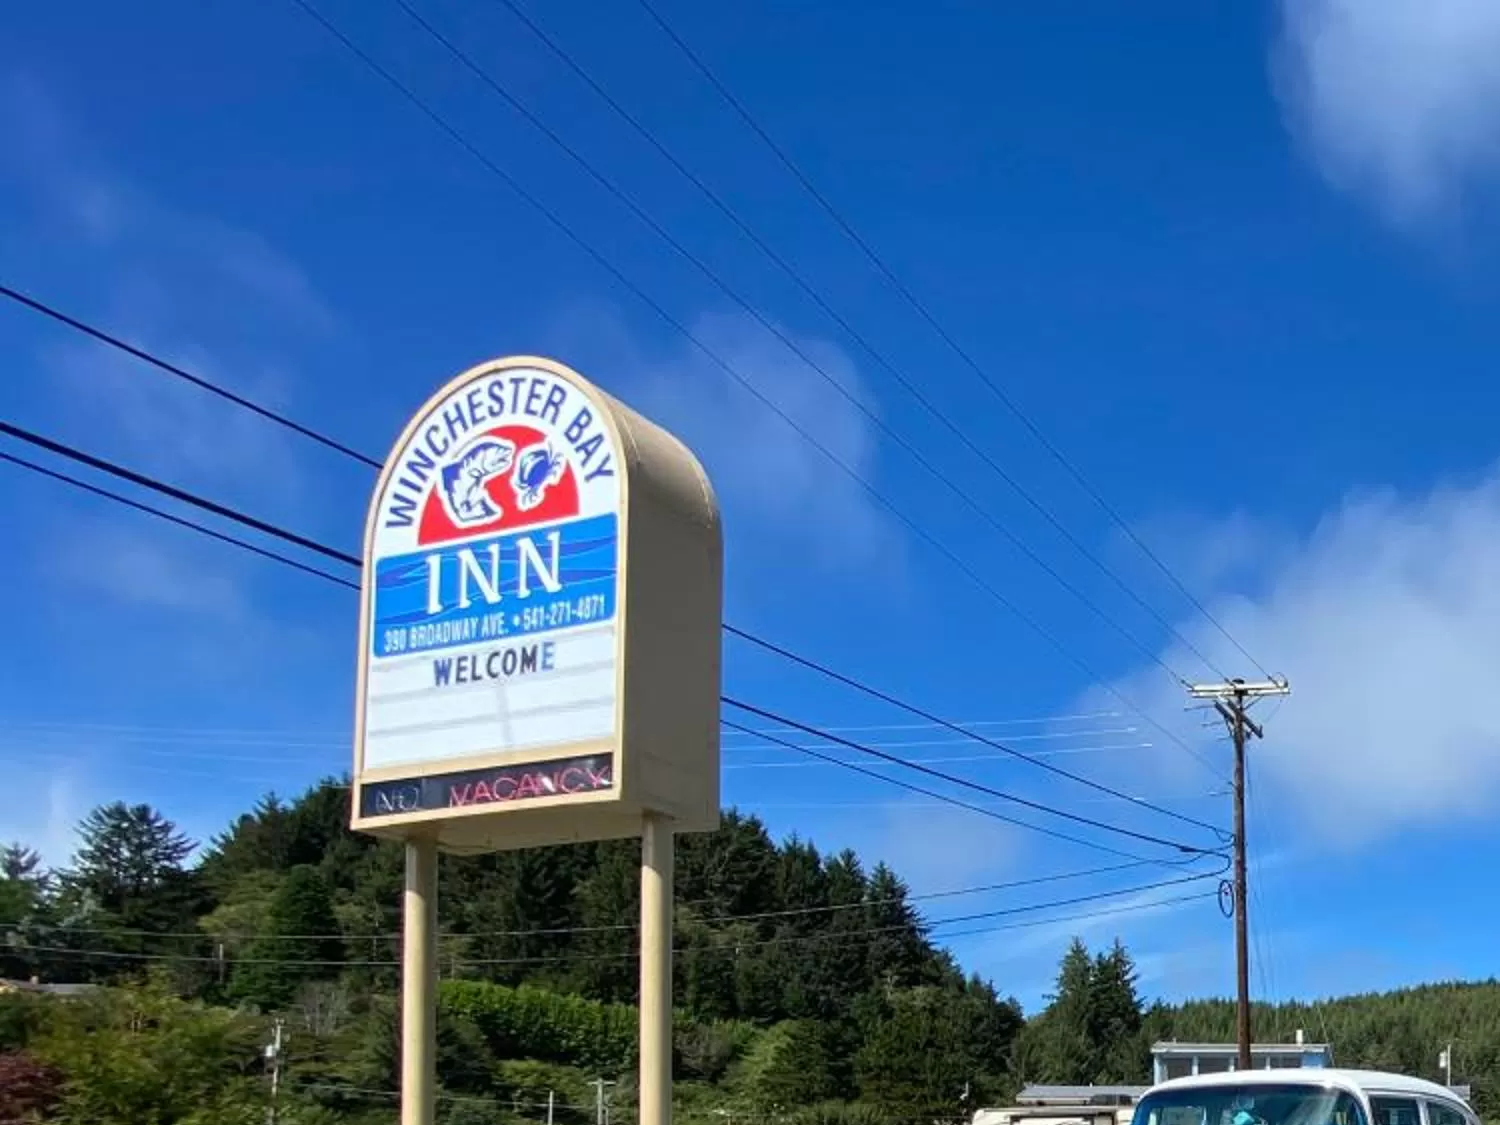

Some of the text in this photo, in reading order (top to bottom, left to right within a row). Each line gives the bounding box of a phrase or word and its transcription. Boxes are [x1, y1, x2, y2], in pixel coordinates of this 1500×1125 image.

[386, 377, 614, 529] WINCHESTER BAY
[425, 531, 563, 615] INN
[409, 616, 479, 649] BROADWAY
[481, 611, 509, 638] AVE.
[433, 640, 556, 687] WELCOME
[450, 765, 613, 808] VACANCY
